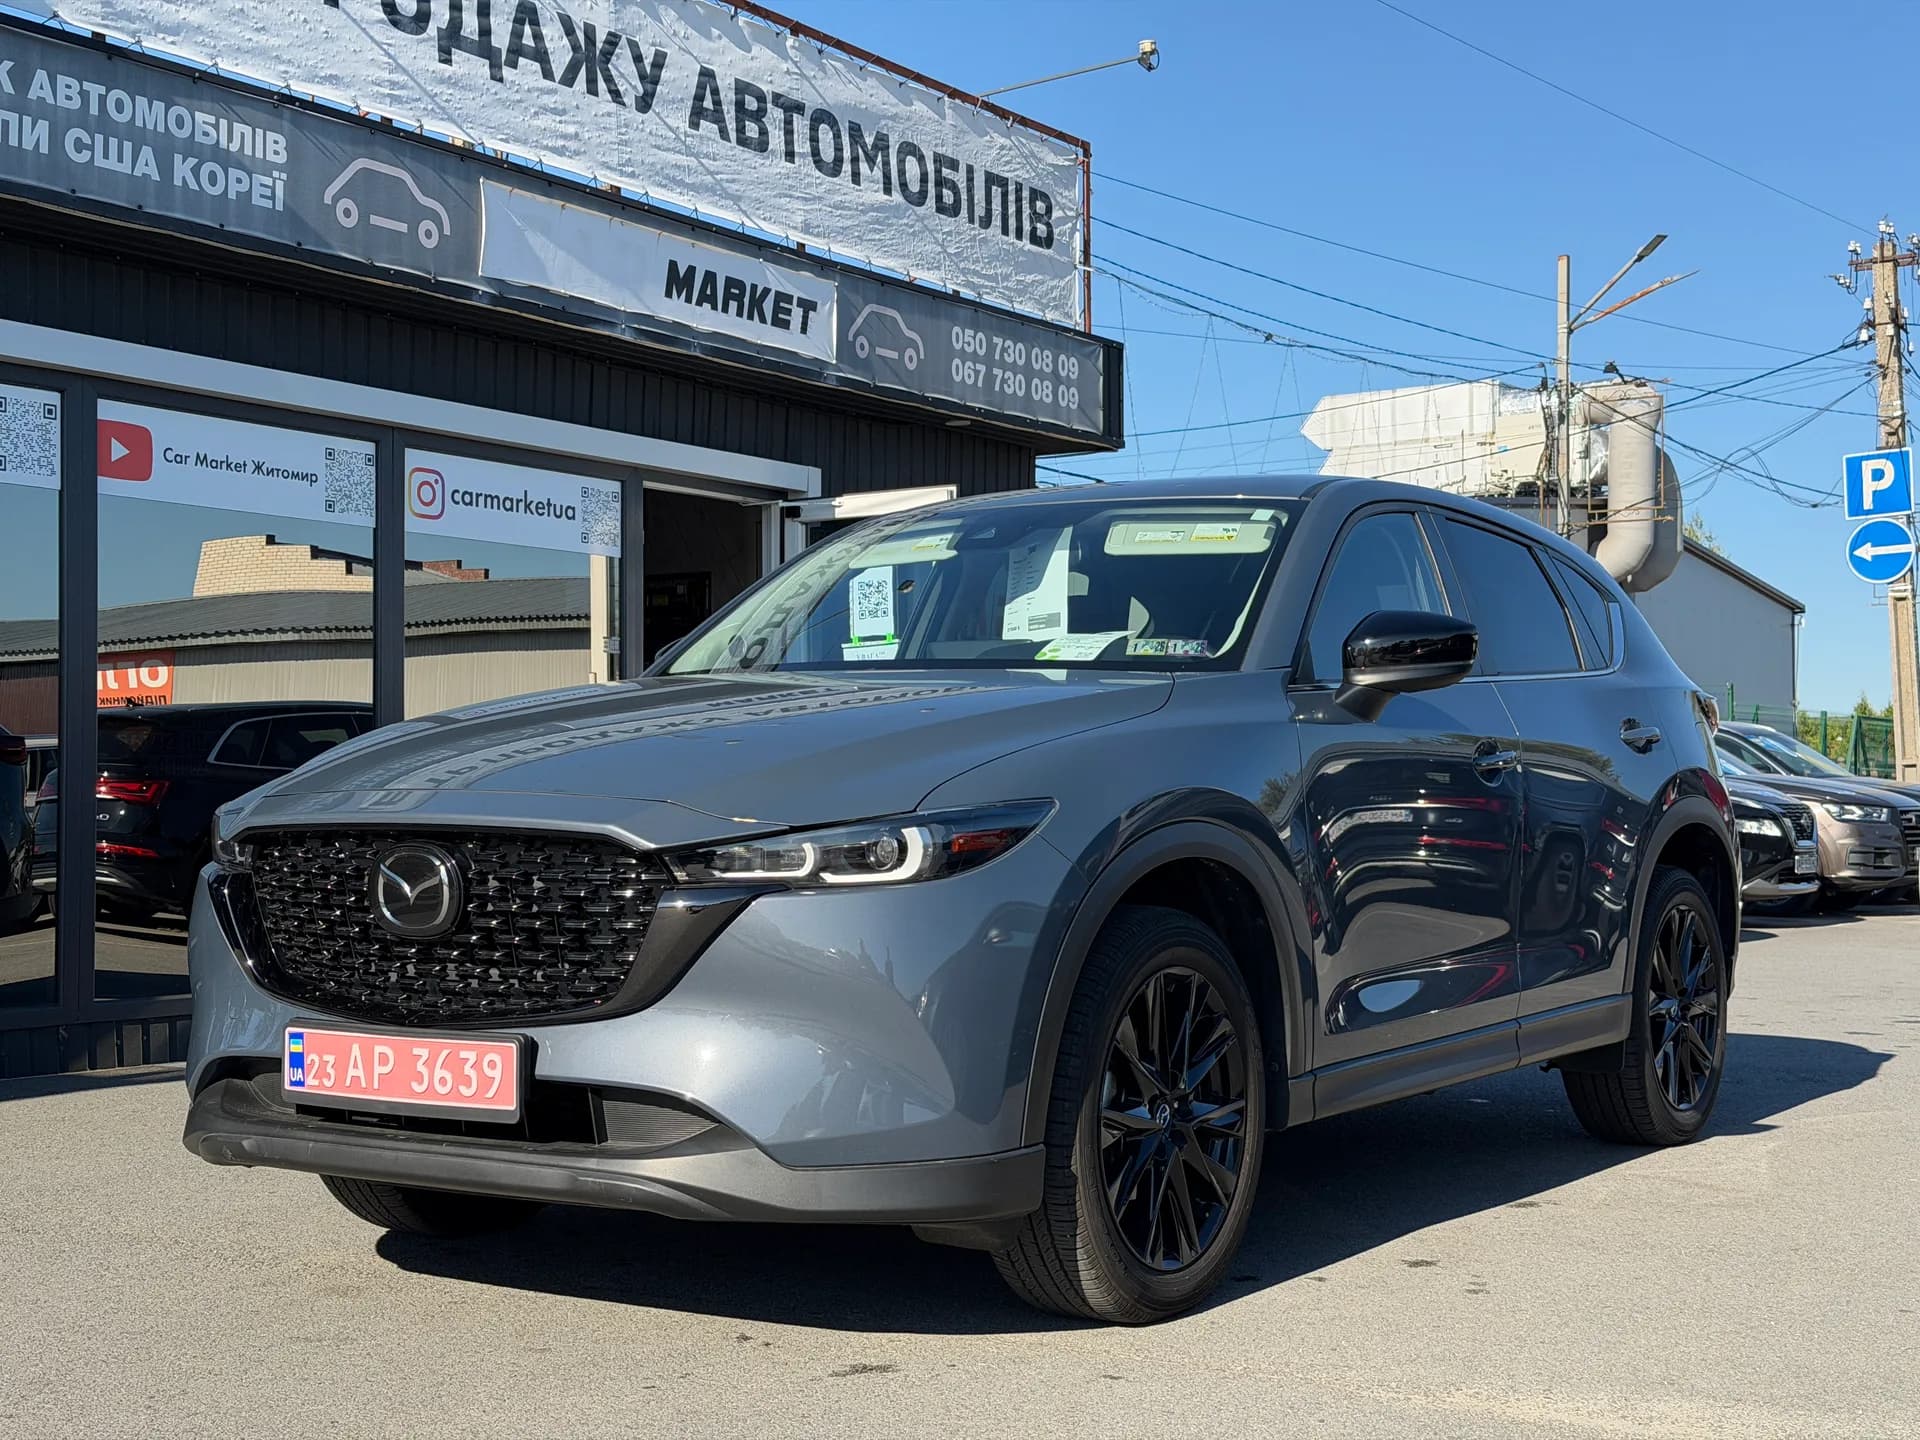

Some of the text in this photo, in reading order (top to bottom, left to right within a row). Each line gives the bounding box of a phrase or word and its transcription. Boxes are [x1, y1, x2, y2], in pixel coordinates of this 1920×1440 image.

[27, 69, 288, 165] АВТОМОБІЛІВ
[64, 127, 161, 182] США
[173, 153, 288, 212] КОРЕЇ
[688, 64, 1055, 251] АВТОМОБІЛІВ
[664, 258, 818, 335] MARKET
[951, 326, 1079, 380] 050 730 08 09
[951, 358, 1079, 410] 067 730 08 09
[163, 447, 319, 488] Car Market Житомир
[1861, 458, 1895, 511] P
[451, 489, 576, 521] carmarketua
[289, 1067, 304, 1082] UA
[306, 1043, 503, 1099] 23 AP 3639
